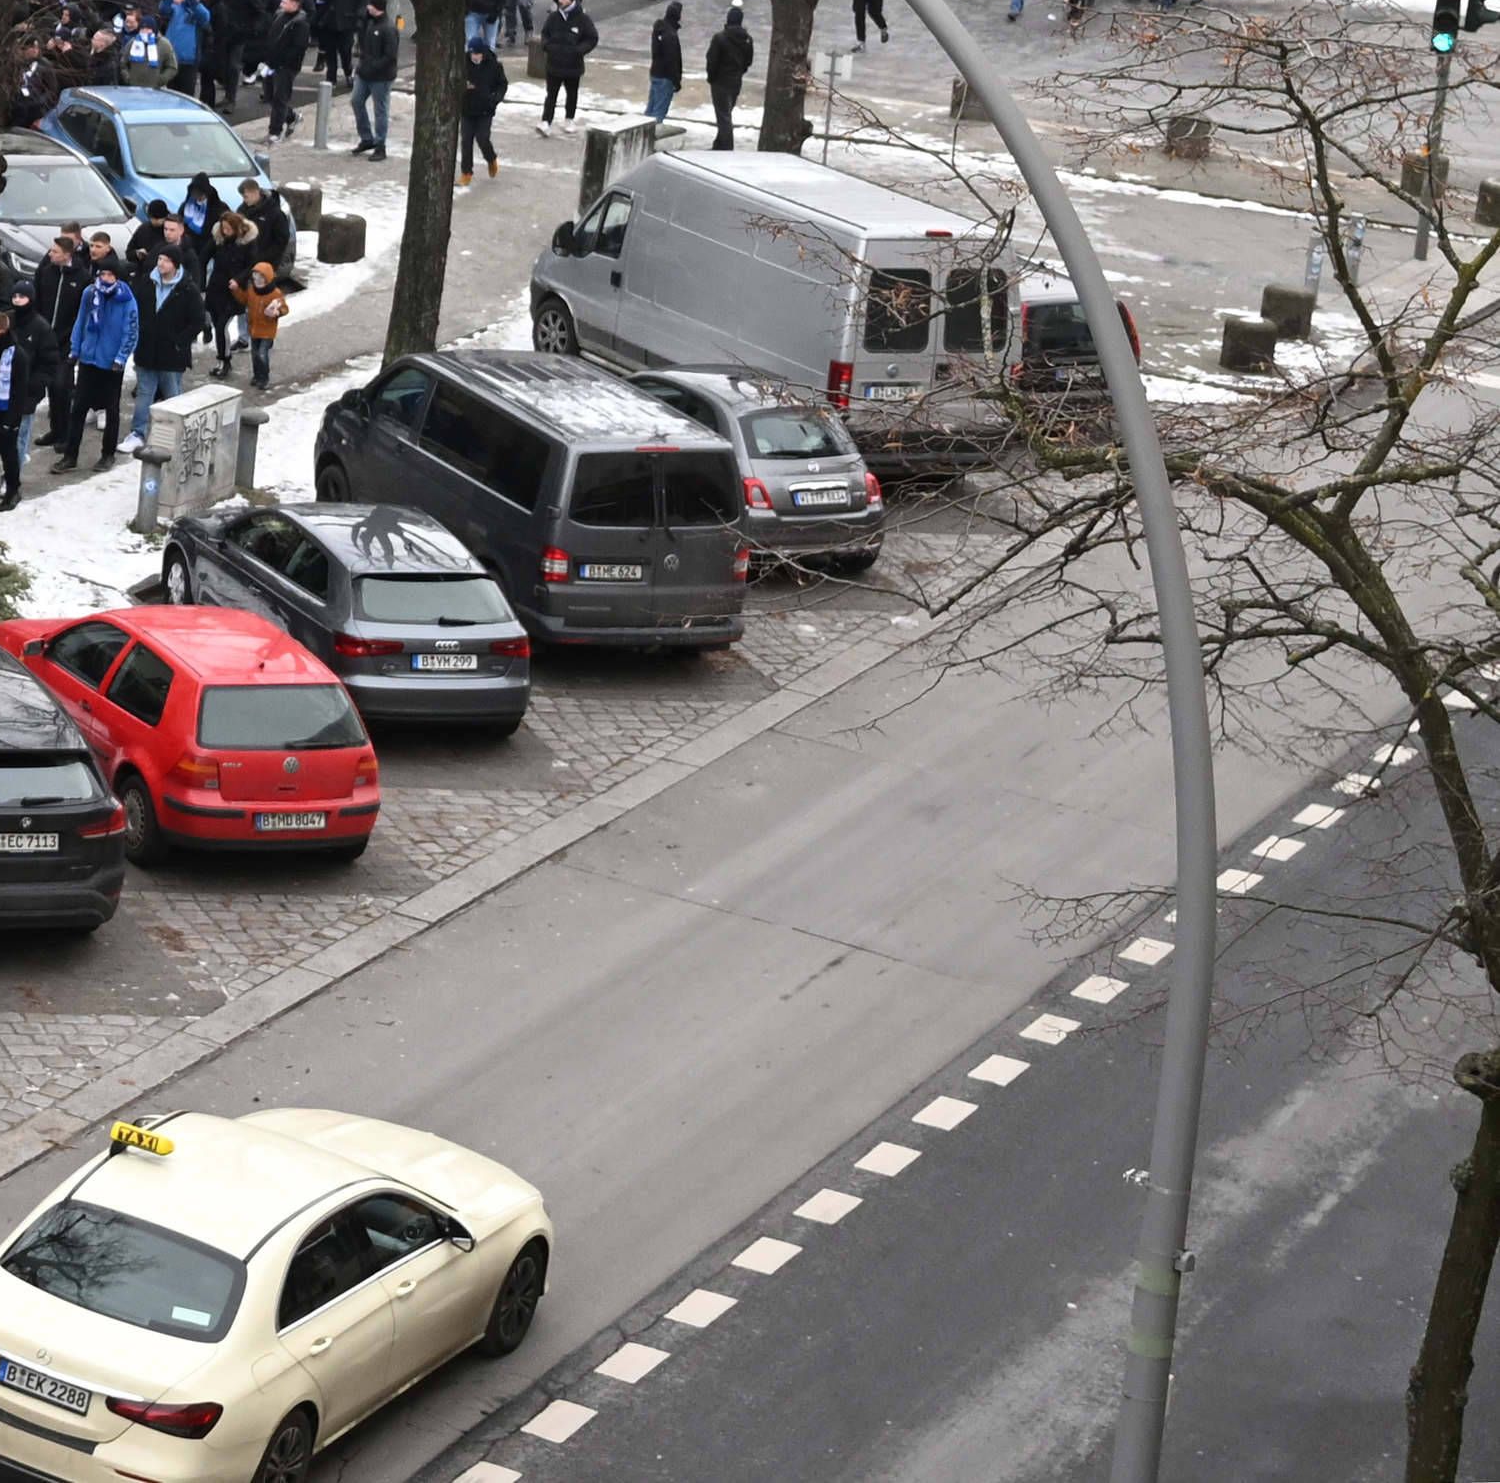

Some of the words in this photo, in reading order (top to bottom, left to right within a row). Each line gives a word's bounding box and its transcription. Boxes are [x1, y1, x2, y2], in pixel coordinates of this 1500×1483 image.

[453, 655, 473, 667] 299
[7, 835, 23, 848] EC
[27, 835, 57, 848] 7113
[119, 1126, 158, 1151] TAXI
[6, 1365, 17, 1382] B
[25, 1372, 47, 1393] EK
[48, 1381, 86, 1408] 2288
